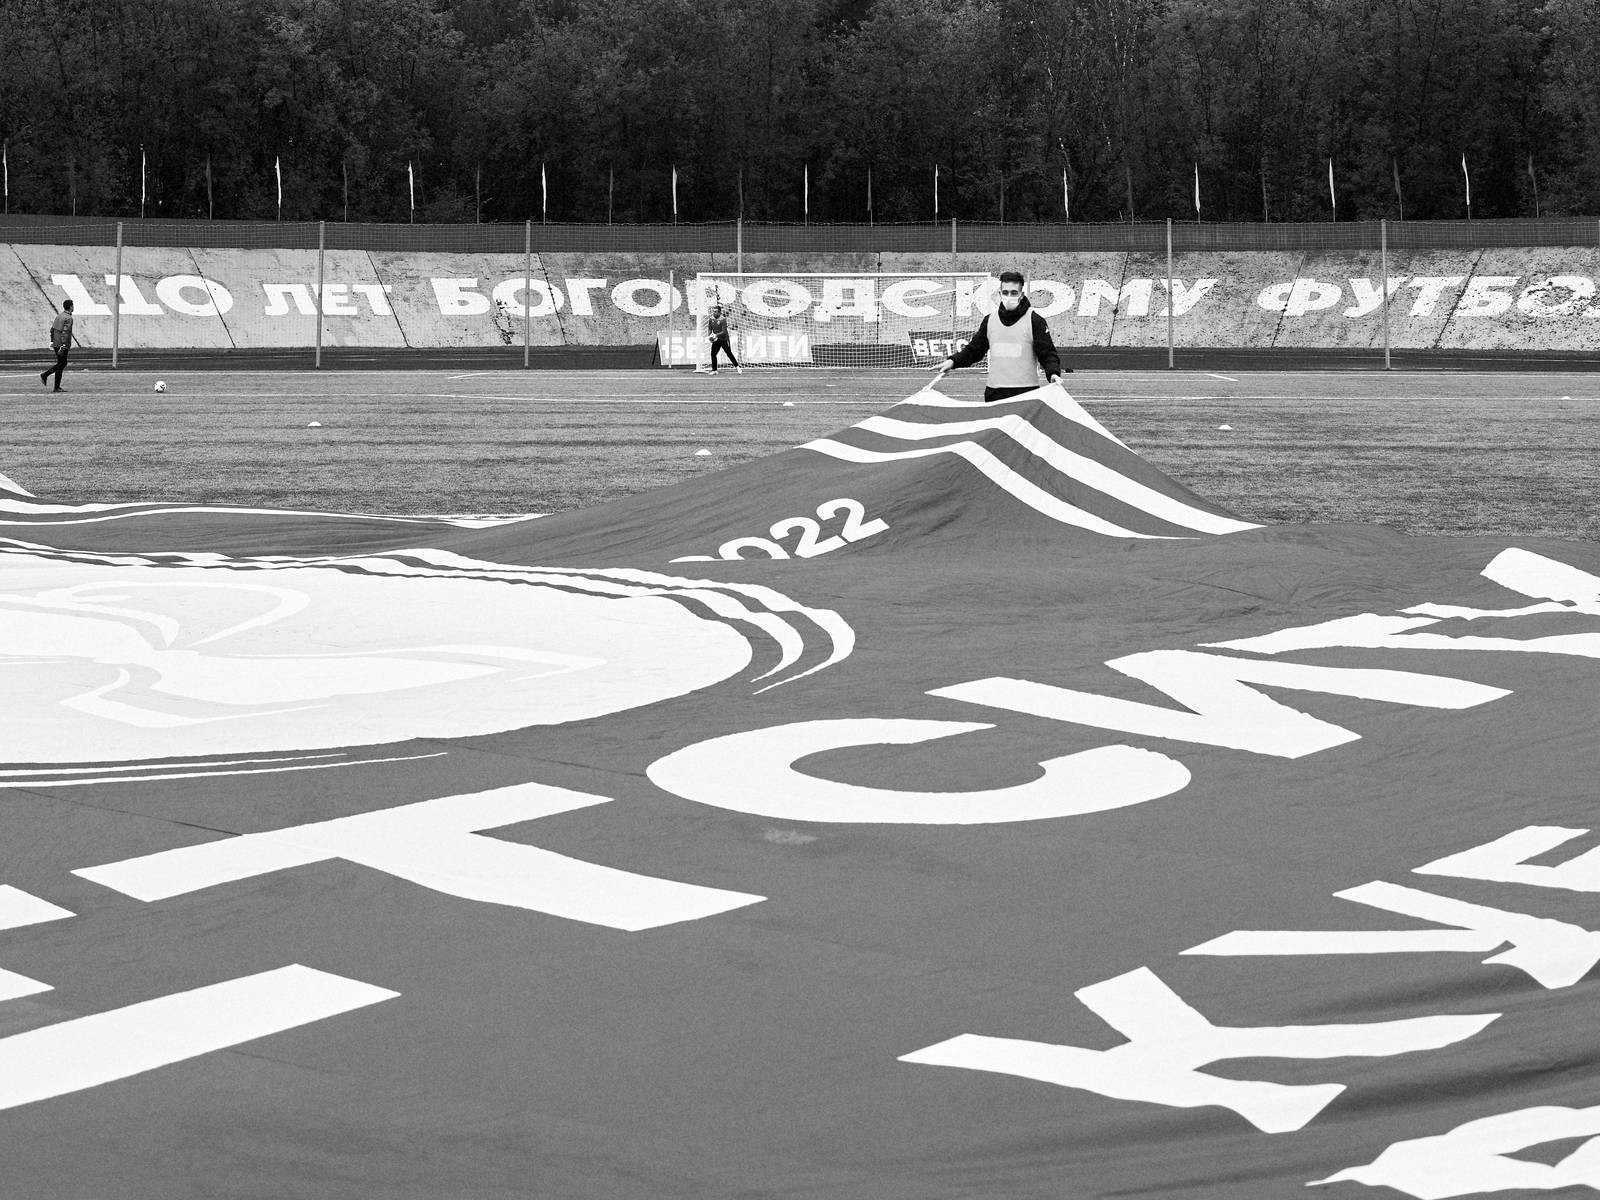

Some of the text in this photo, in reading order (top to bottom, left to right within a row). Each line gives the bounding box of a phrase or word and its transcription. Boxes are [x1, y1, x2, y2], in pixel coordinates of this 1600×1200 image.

[52, 274, 234, 317] 110
[262, 283, 393, 316] ЛЕТ
[430, 277, 1217, 321] БОГОРОДСКОМУ
